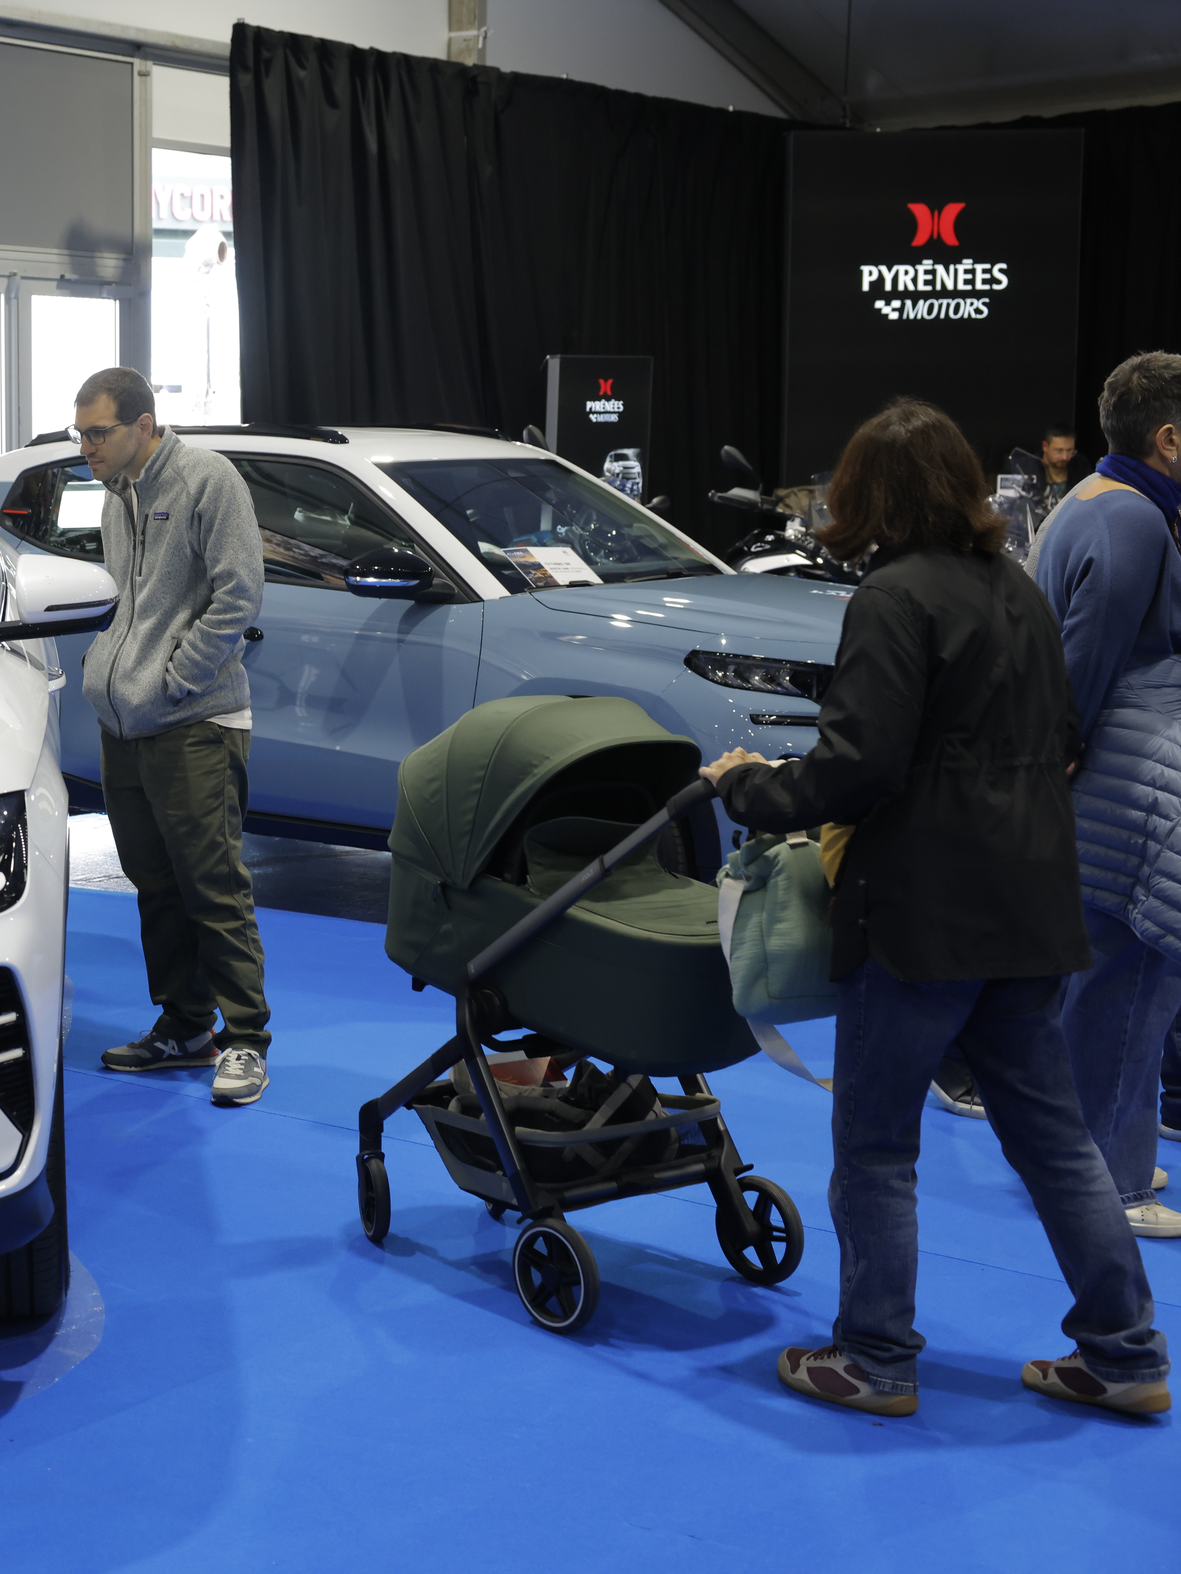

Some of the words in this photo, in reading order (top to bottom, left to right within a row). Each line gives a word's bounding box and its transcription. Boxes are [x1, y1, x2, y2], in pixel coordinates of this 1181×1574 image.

[151, 182, 233, 222] YCOR
[902, 297, 990, 320] MOTORS
[596, 413, 619, 422] MOTORS
